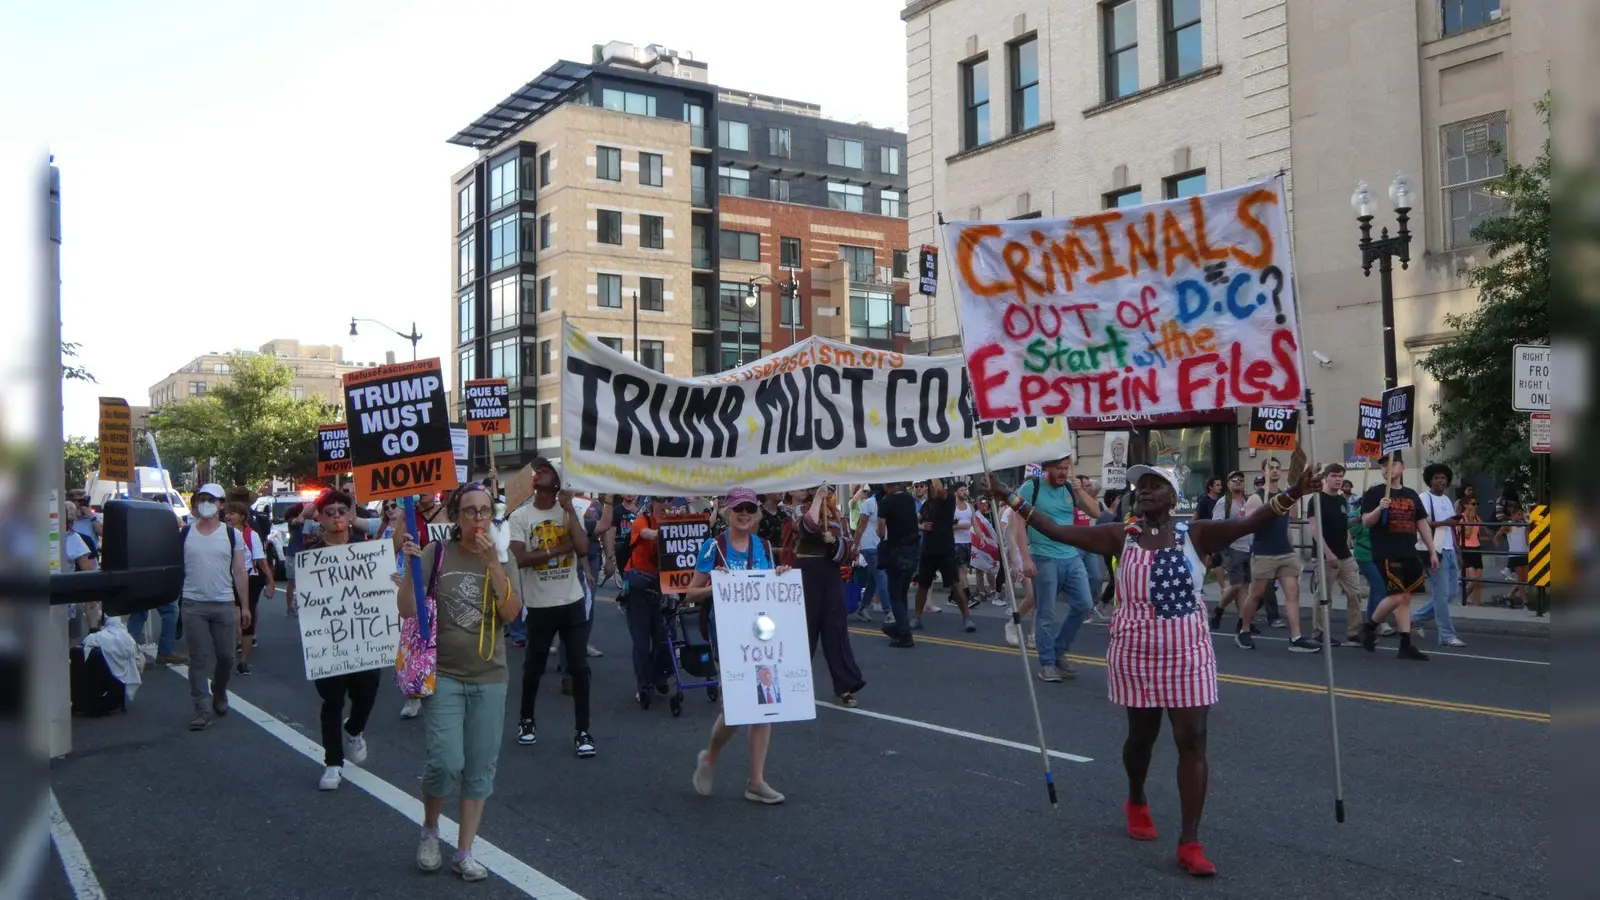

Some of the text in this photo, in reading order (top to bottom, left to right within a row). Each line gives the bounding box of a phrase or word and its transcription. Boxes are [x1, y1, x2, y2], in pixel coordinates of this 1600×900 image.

[1003, 303, 1098, 340] OUT
[1117, 285, 1160, 332] of
[1023, 325, 1129, 373] Start
[1148, 319, 1216, 360] the
[1522, 352, 1544, 361] RIGHT
[348, 360, 433, 381] RefuseFascism.org
[1529, 365, 1550, 376] FRO
[1519, 380, 1543, 389] RIGHT
[349, 375, 440, 411] TRUMP
[466, 386, 509, 399] ¡QUE SE
[1530, 393, 1550, 404] ONL
[473, 397, 502, 408] VAYA
[566, 356, 949, 459] TRUMP MUST GO
[360, 401, 433, 434] MUST
[469, 408, 508, 419] TRUMP
[1258, 408, 1294, 420] MUST
[1360, 406, 1382, 418] TRUM
[481, 421, 500, 432] YA!
[1265, 419, 1284, 431] GO
[1361, 417, 1381, 429] MUST
[320, 429, 348, 440] TRUM
[1256, 433, 1291, 446] NOW!
[1364, 428, 1376, 439] GO
[323, 439, 351, 450] MUST
[382, 430, 419, 456] GO
[330, 449, 345, 459] GO
[371, 457, 442, 492] NOW!
[660, 522, 709, 540] TRUMP
[665, 539, 704, 554] MUST
[312, 550, 340, 567] You
[345, 544, 388, 562] Support
[675, 554, 697, 568] GO
[309, 561, 377, 588] TRUMP
[300, 585, 396, 608] Your Momma
[717, 580, 803, 606] WHO'S NEXT?
[320, 604, 348, 620] And
[305, 628, 323, 638] are
[330, 614, 402, 644] BITCH
[740, 641, 784, 664] YOU!
